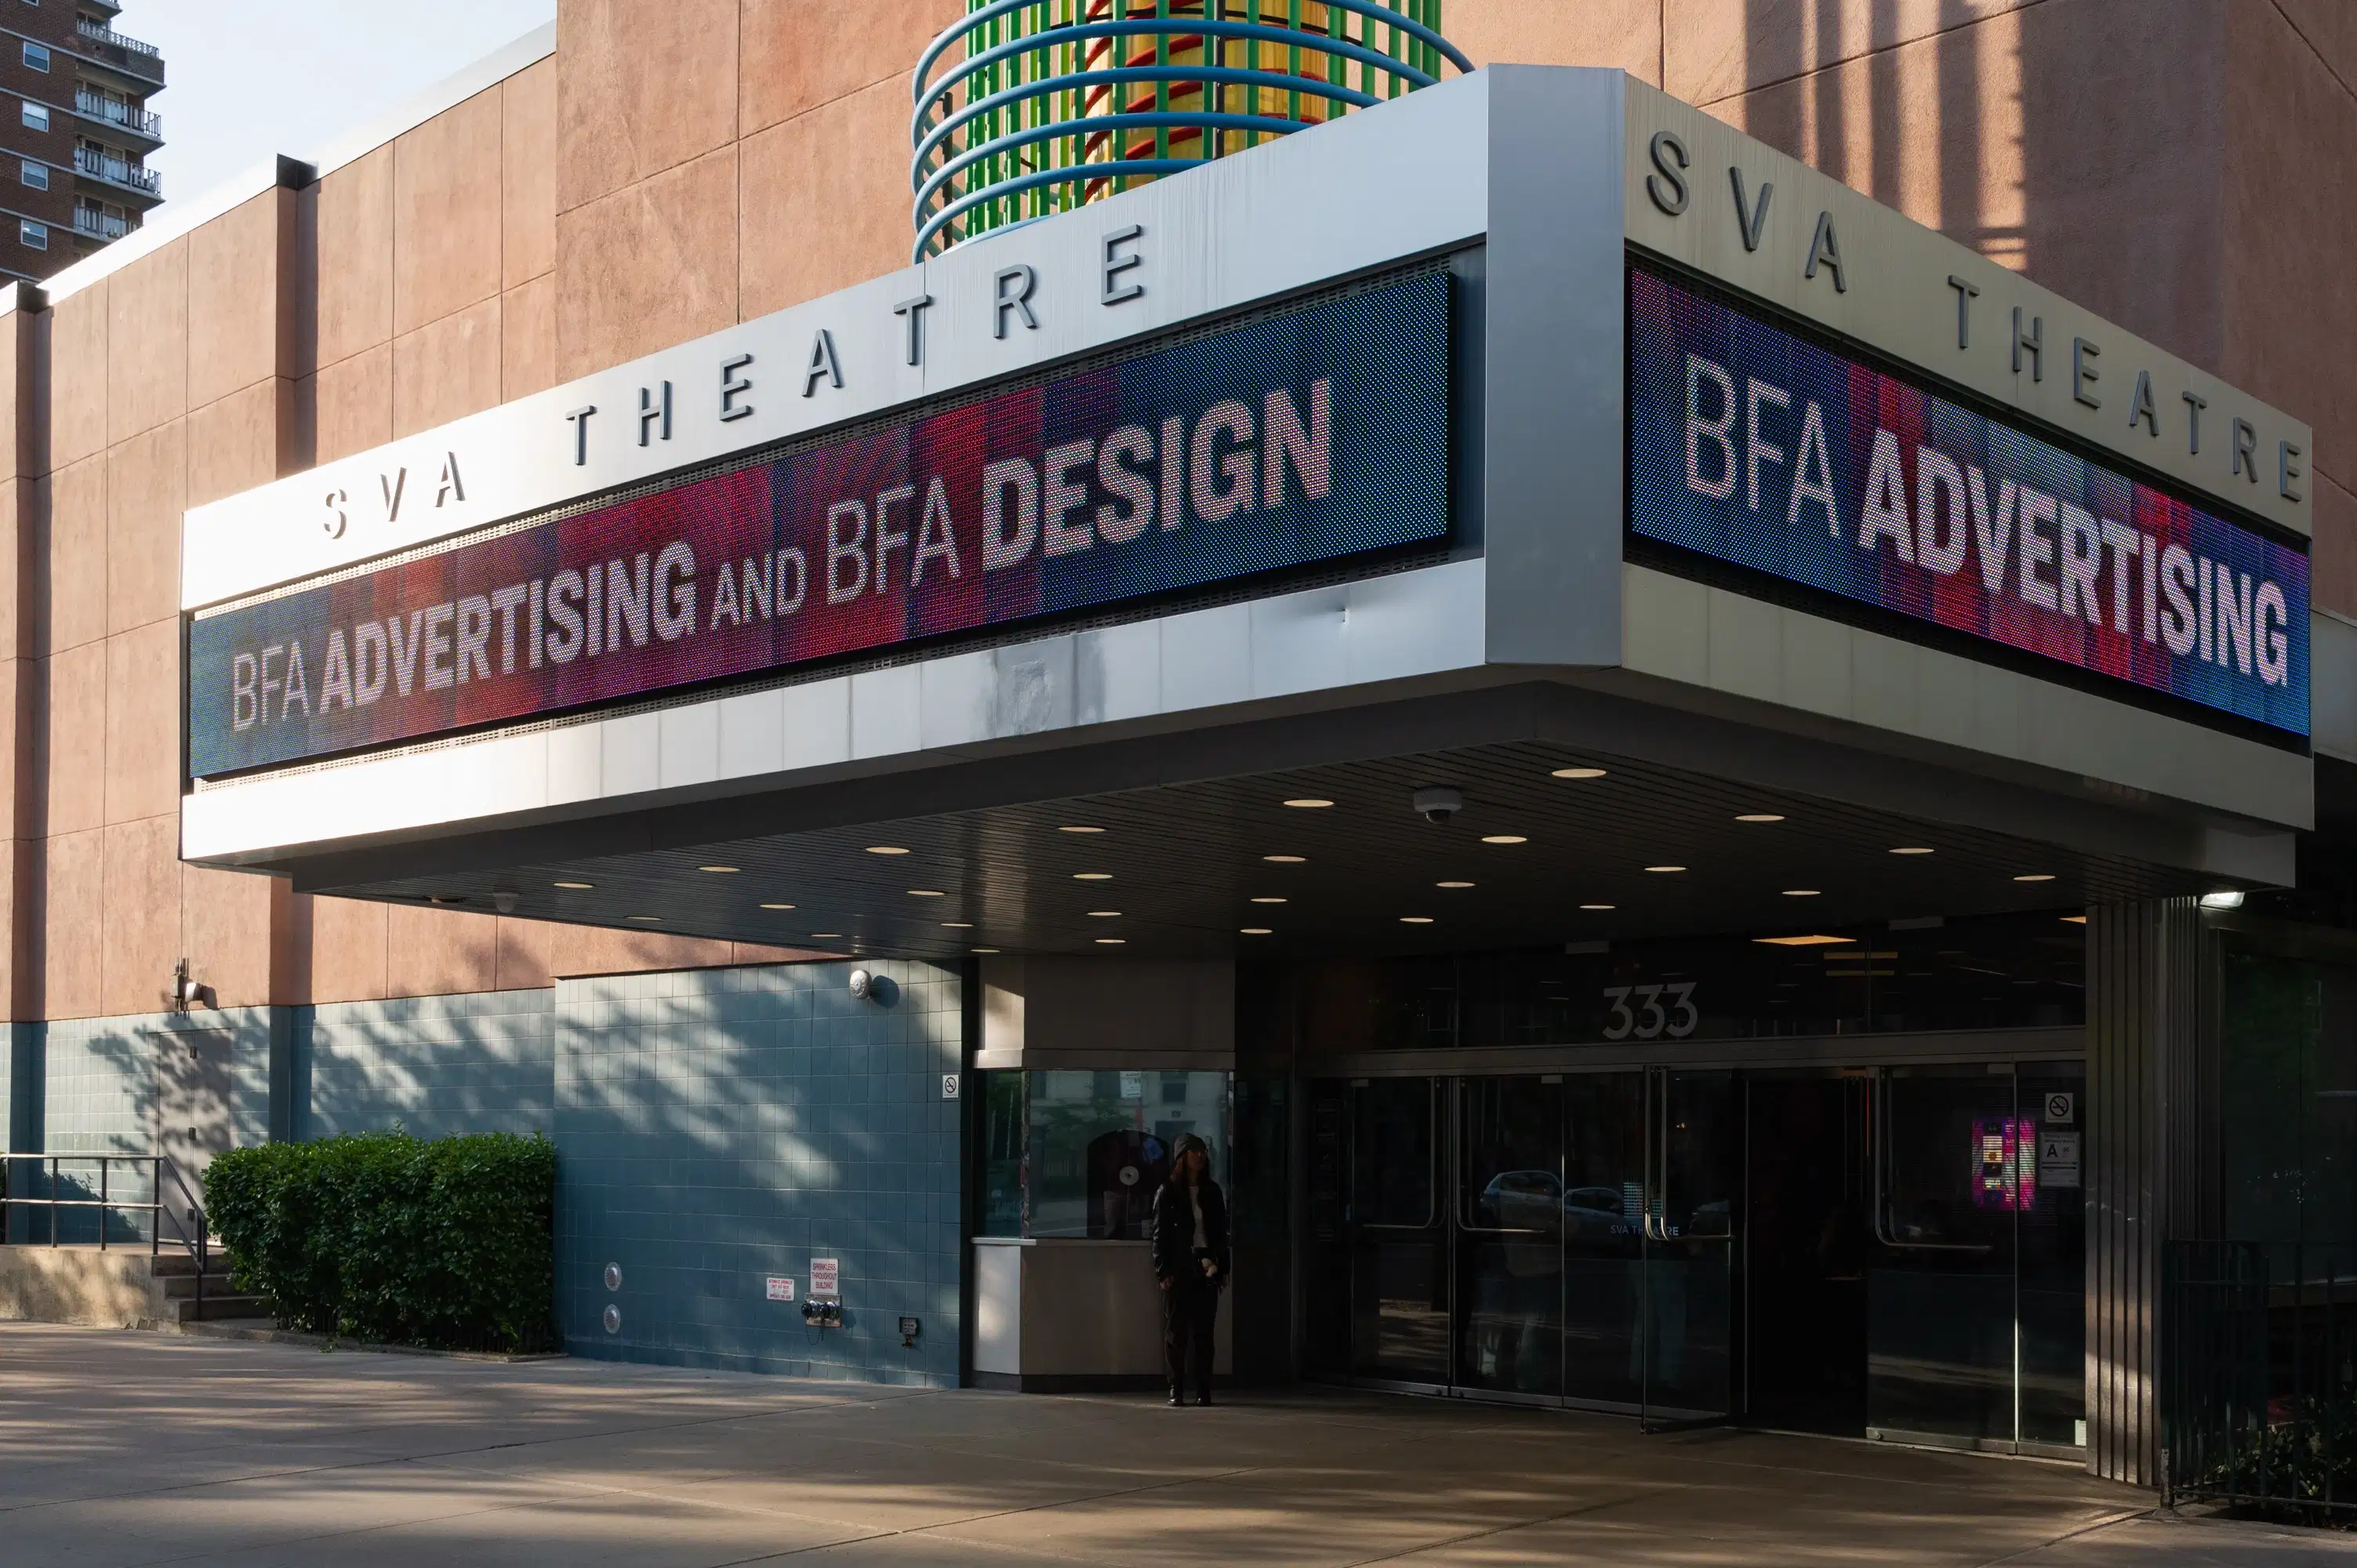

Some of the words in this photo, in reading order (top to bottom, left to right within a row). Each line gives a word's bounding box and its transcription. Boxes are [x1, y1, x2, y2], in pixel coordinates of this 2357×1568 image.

[1647, 130, 1847, 292] SVA
[1948, 274, 2304, 503] THEATRE
[323, 451, 467, 539] SVA
[565, 223, 1143, 466] THEATRE
[1685, 353, 1841, 538] BFA
[1858, 429, 2289, 688] ADVERTISING
[233, 639, 311, 731] BFA
[319, 541, 697, 714] ADVERTISING
[710, 546, 807, 630] AND
[826, 477, 960, 605] BFA
[982, 378, 1331, 572] DESIGN
[1603, 982, 1698, 1040] 333
[2046, 1144, 2058, 1157] A
[1610, 1225, 1629, 1236] SVA
[812, 1272, 837, 1280] THROUGHOUT
[815, 1281, 833, 1290] BUILDING
